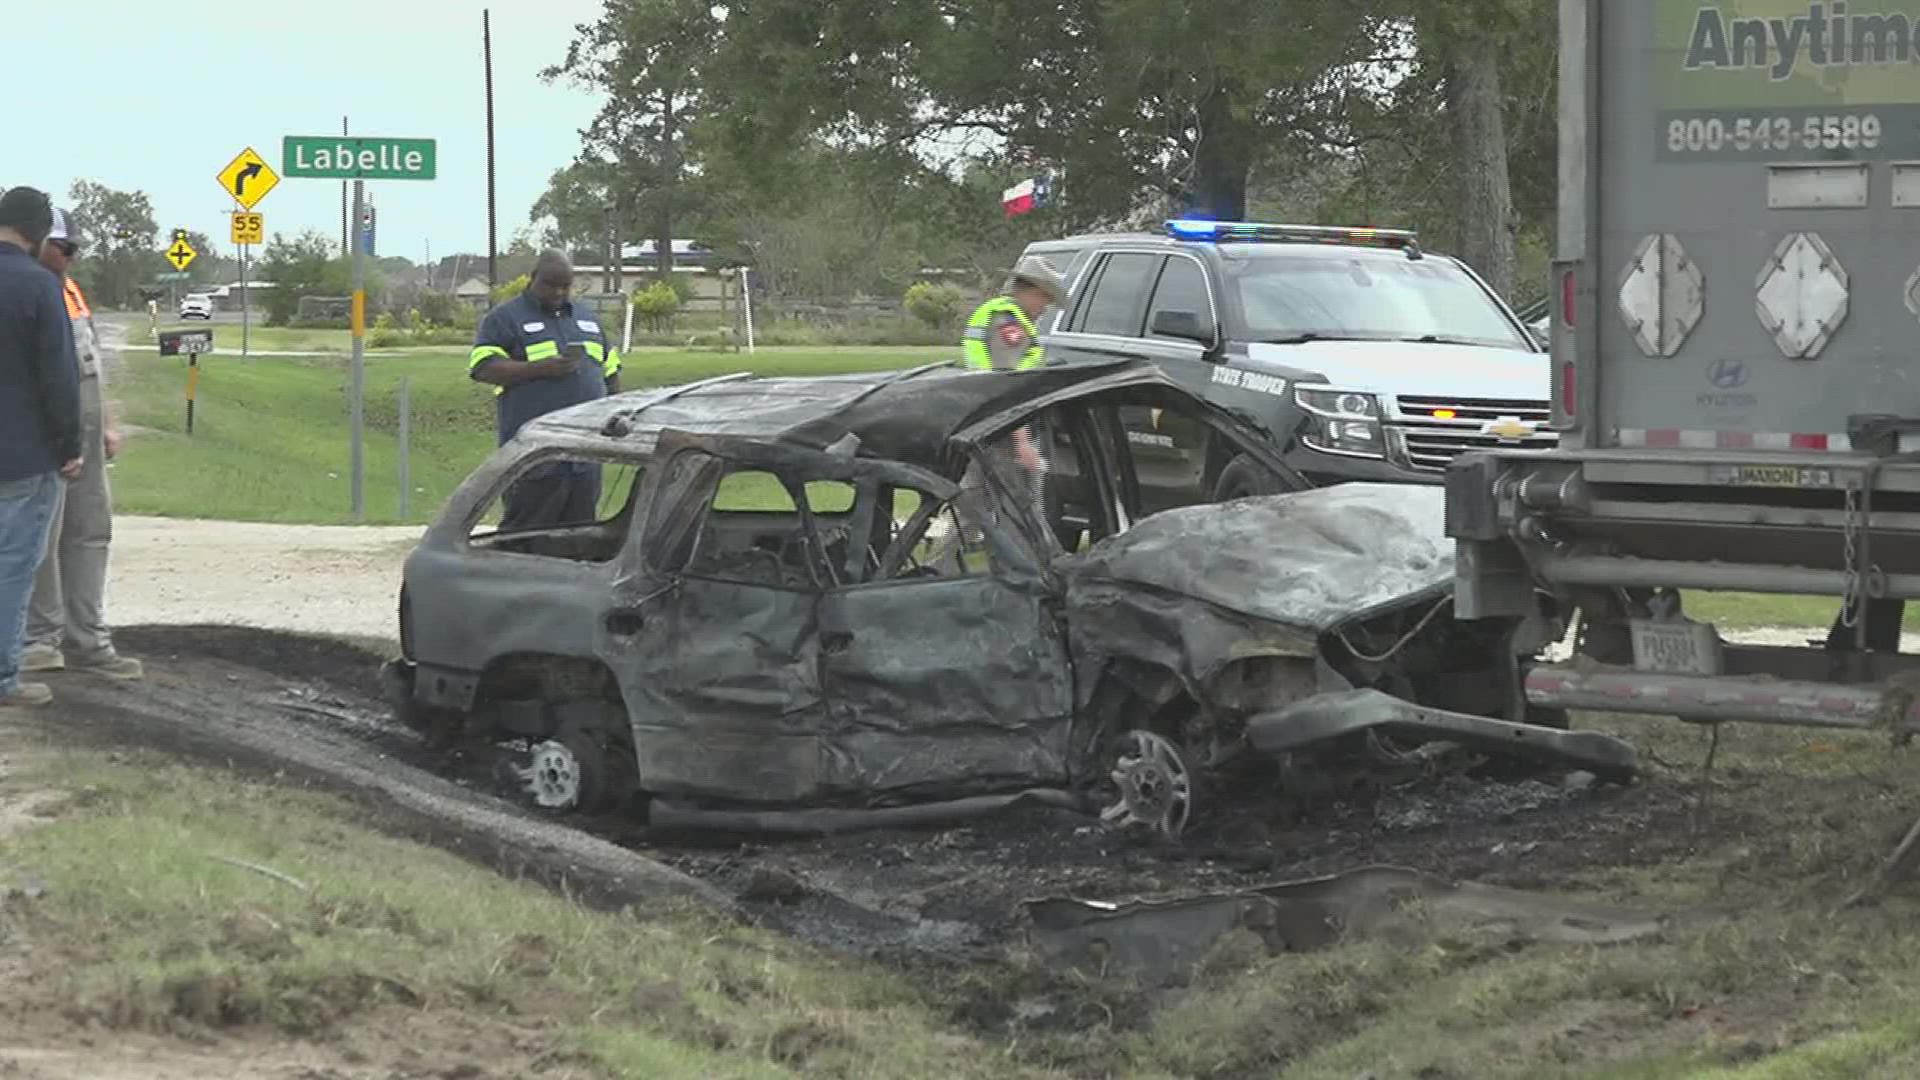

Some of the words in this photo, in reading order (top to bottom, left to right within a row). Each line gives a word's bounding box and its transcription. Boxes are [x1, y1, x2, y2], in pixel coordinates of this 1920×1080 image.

[1667, 114, 1881, 151] 800-543-5589
[295, 144, 423, 172] Labelle
[234, 216, 260, 231] 55
[1211, 365, 1242, 386] STATE
[1240, 371, 1286, 395] TROOPER
